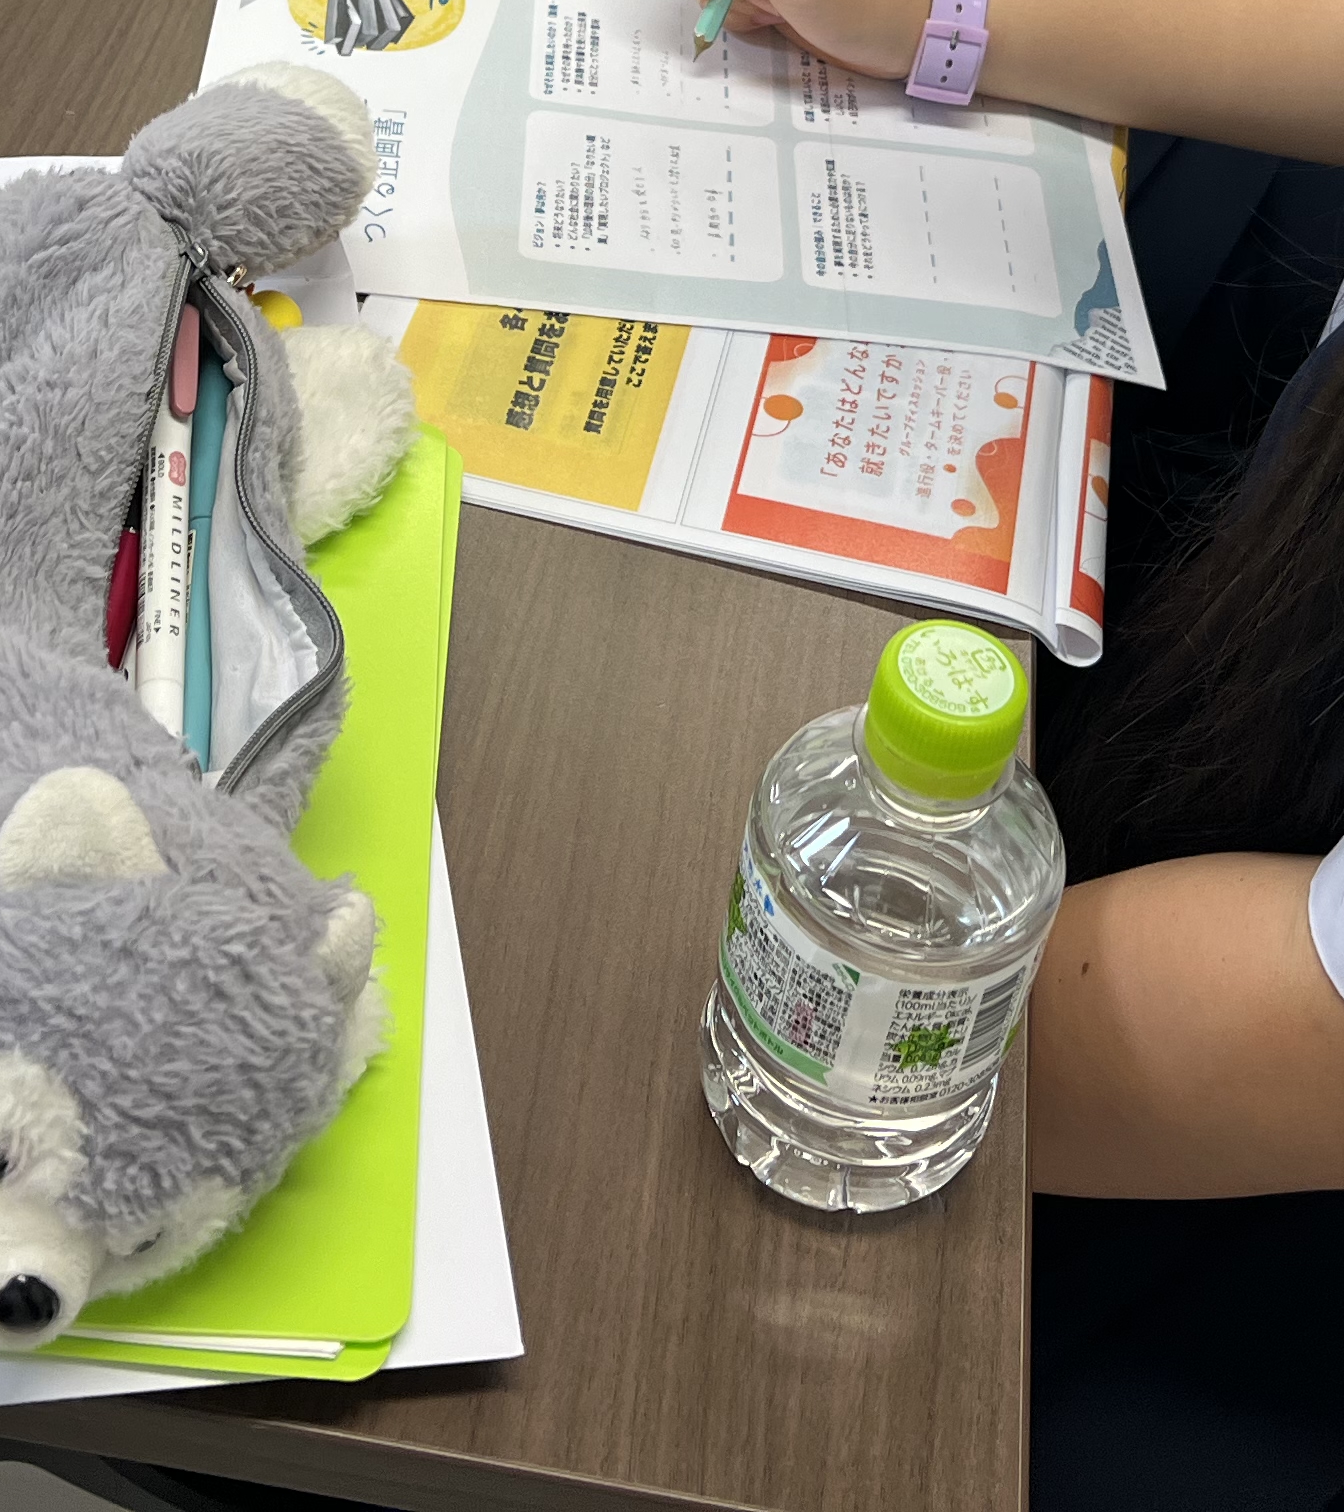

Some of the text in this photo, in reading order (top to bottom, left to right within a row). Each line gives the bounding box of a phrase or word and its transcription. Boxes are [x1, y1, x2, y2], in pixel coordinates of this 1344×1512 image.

[583, 318, 635, 435] 質問を用意していただ
[819, 340, 872, 478] 「あなたはどんな
[858, 343, 906, 478] 就きたいですか
[898, 359, 926, 457] グループディスカッション
[947, 369, 972, 456] を決めてください
[157, 458, 166, 479] BOLD
[154, 609, 162, 627] FINE
[168, 494, 183, 637] MILDLINER
